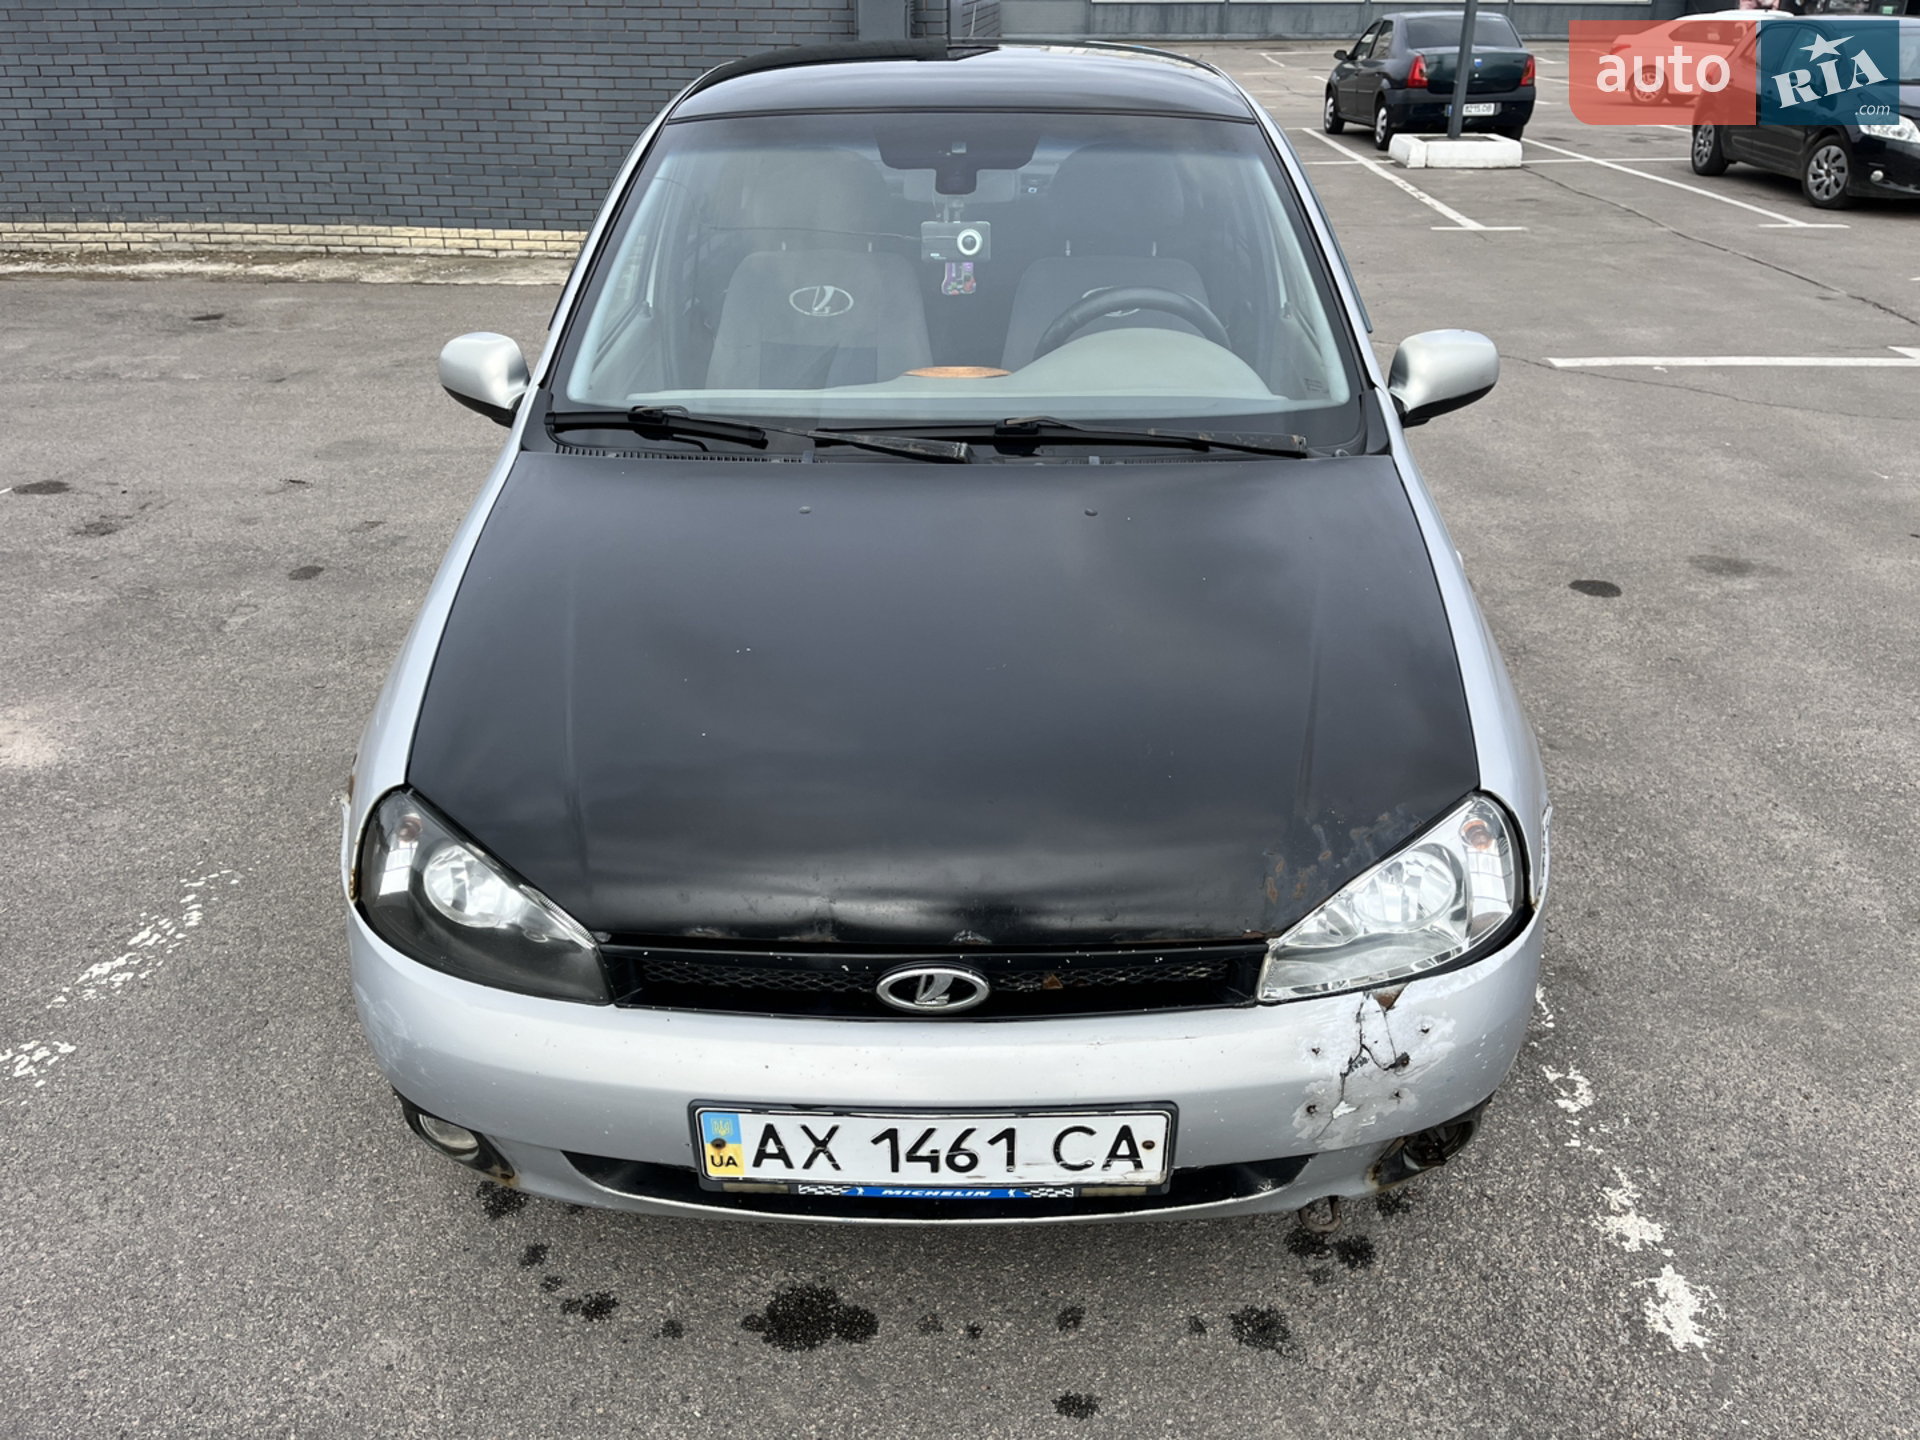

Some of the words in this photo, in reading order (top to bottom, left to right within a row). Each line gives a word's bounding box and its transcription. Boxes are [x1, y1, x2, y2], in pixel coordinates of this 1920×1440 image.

[752, 1123, 842, 1171] AX
[870, 1127, 1017, 1173] 1461
[1052, 1124, 1144, 1171] CA
[710, 1155, 738, 1168] UA
[881, 1189, 991, 1197] MICHELIN
